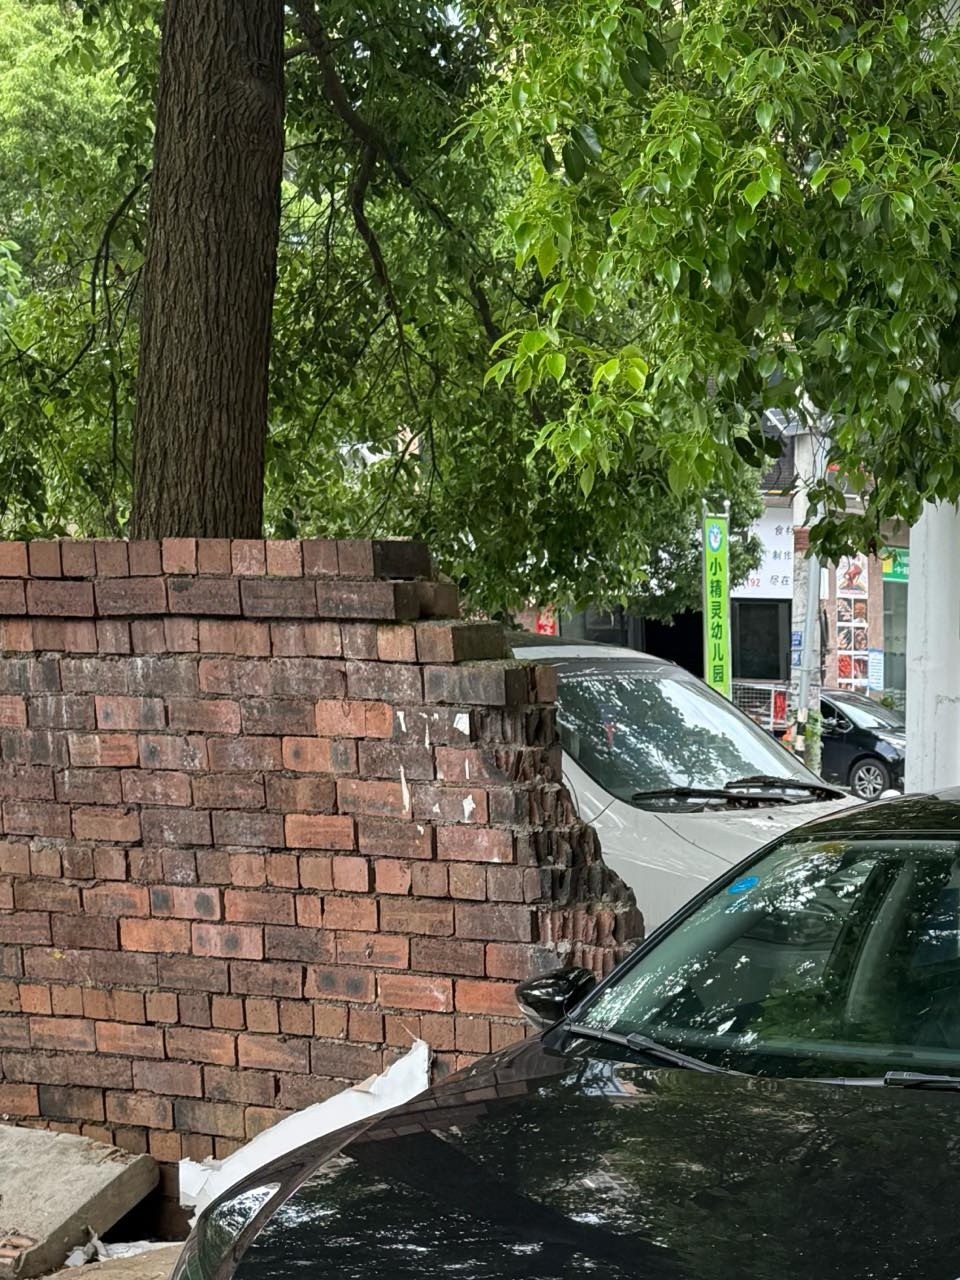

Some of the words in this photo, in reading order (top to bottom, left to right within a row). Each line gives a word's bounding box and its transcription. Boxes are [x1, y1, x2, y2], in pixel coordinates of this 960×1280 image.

[709, 557, 724, 683] 小精灵幼儿园
